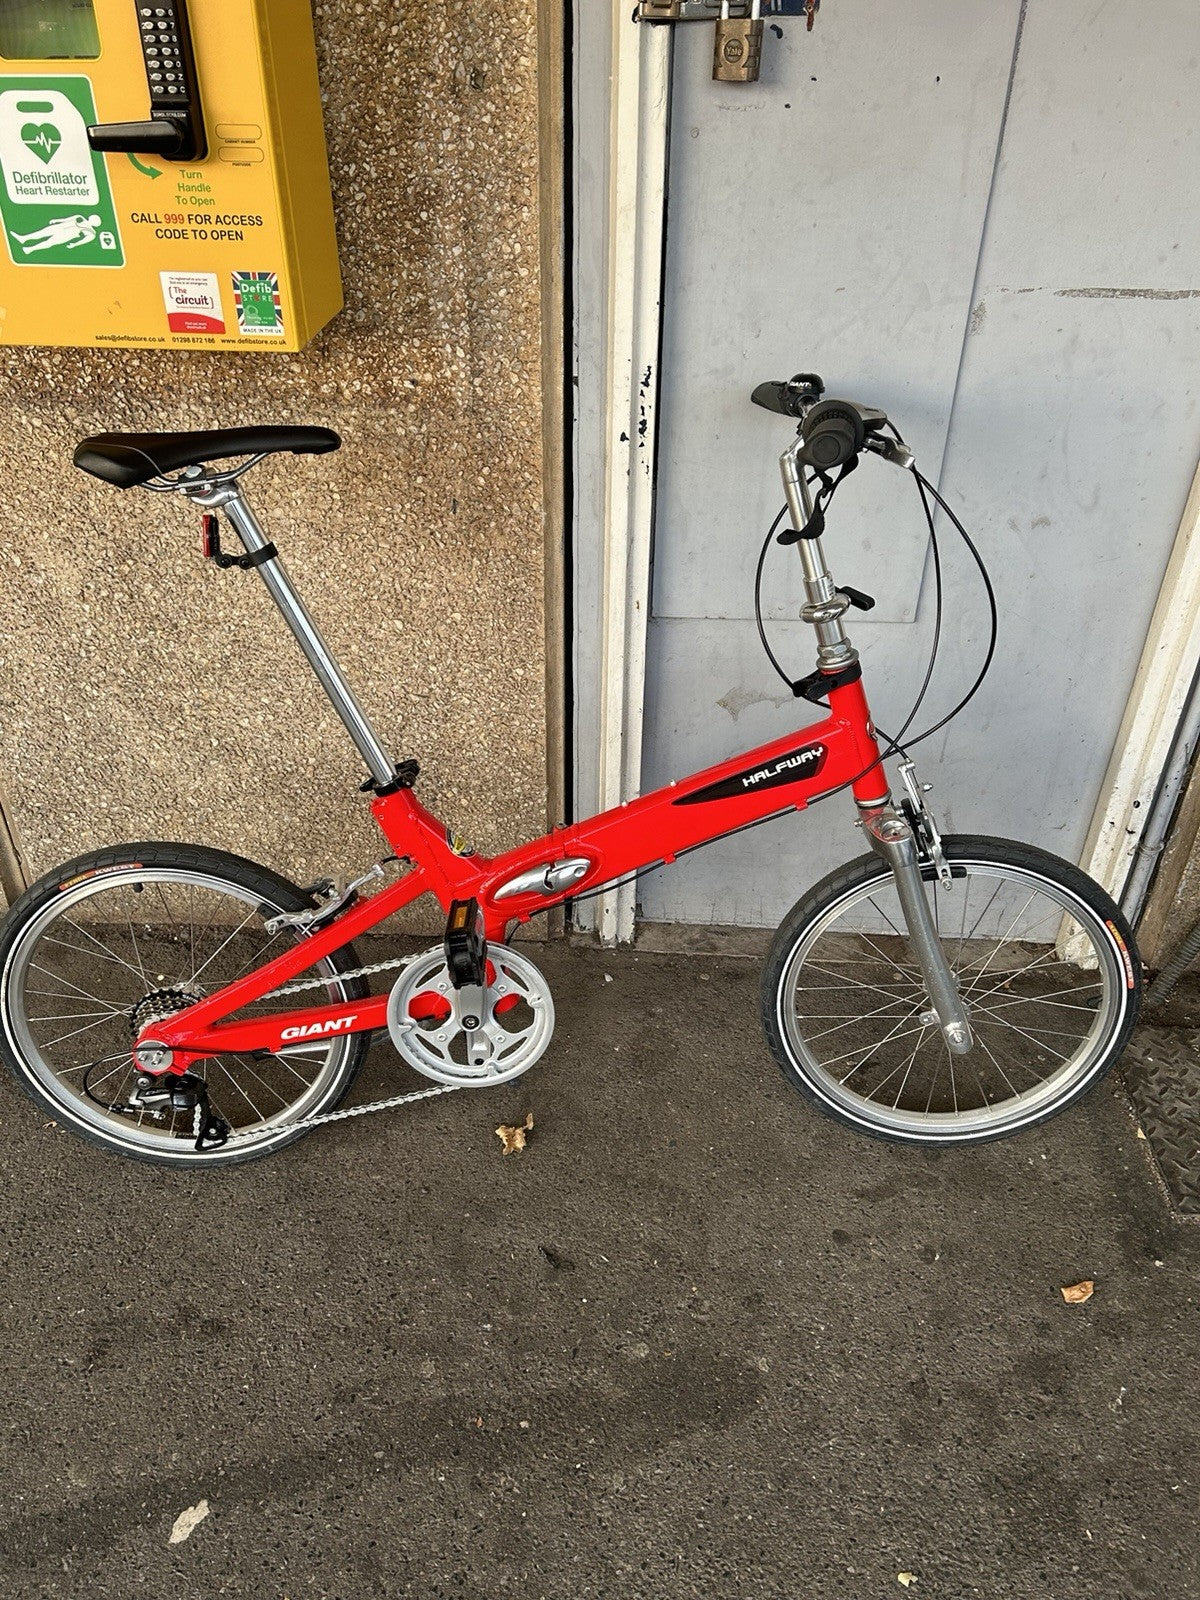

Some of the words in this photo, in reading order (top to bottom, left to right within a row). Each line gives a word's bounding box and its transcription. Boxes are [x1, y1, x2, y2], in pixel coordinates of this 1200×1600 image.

[726, 46, 742, 56] Yale
[12, 171, 87, 184] Defibrillator
[179, 170, 202, 178] Turn
[16, 186, 43, 195] Heart
[45, 186, 89, 196] Restarter
[177, 183, 211, 192] Handle
[175, 195, 187, 205] To
[190, 196, 215, 206] Open
[131, 213, 162, 223] CALL
[164, 214, 184, 224] 999
[188, 214, 212, 224] FOR
[215, 215, 263, 226] ACCESS
[155, 228, 189, 239] CODE
[191, 229, 207, 240] TO
[211, 230, 243, 240] OPEN
[241, 282, 272, 293] Defib
[176, 295, 209, 305] circuit
[742, 746, 823, 787] HALFWAY
[280, 1015, 358, 1040] GIANT
